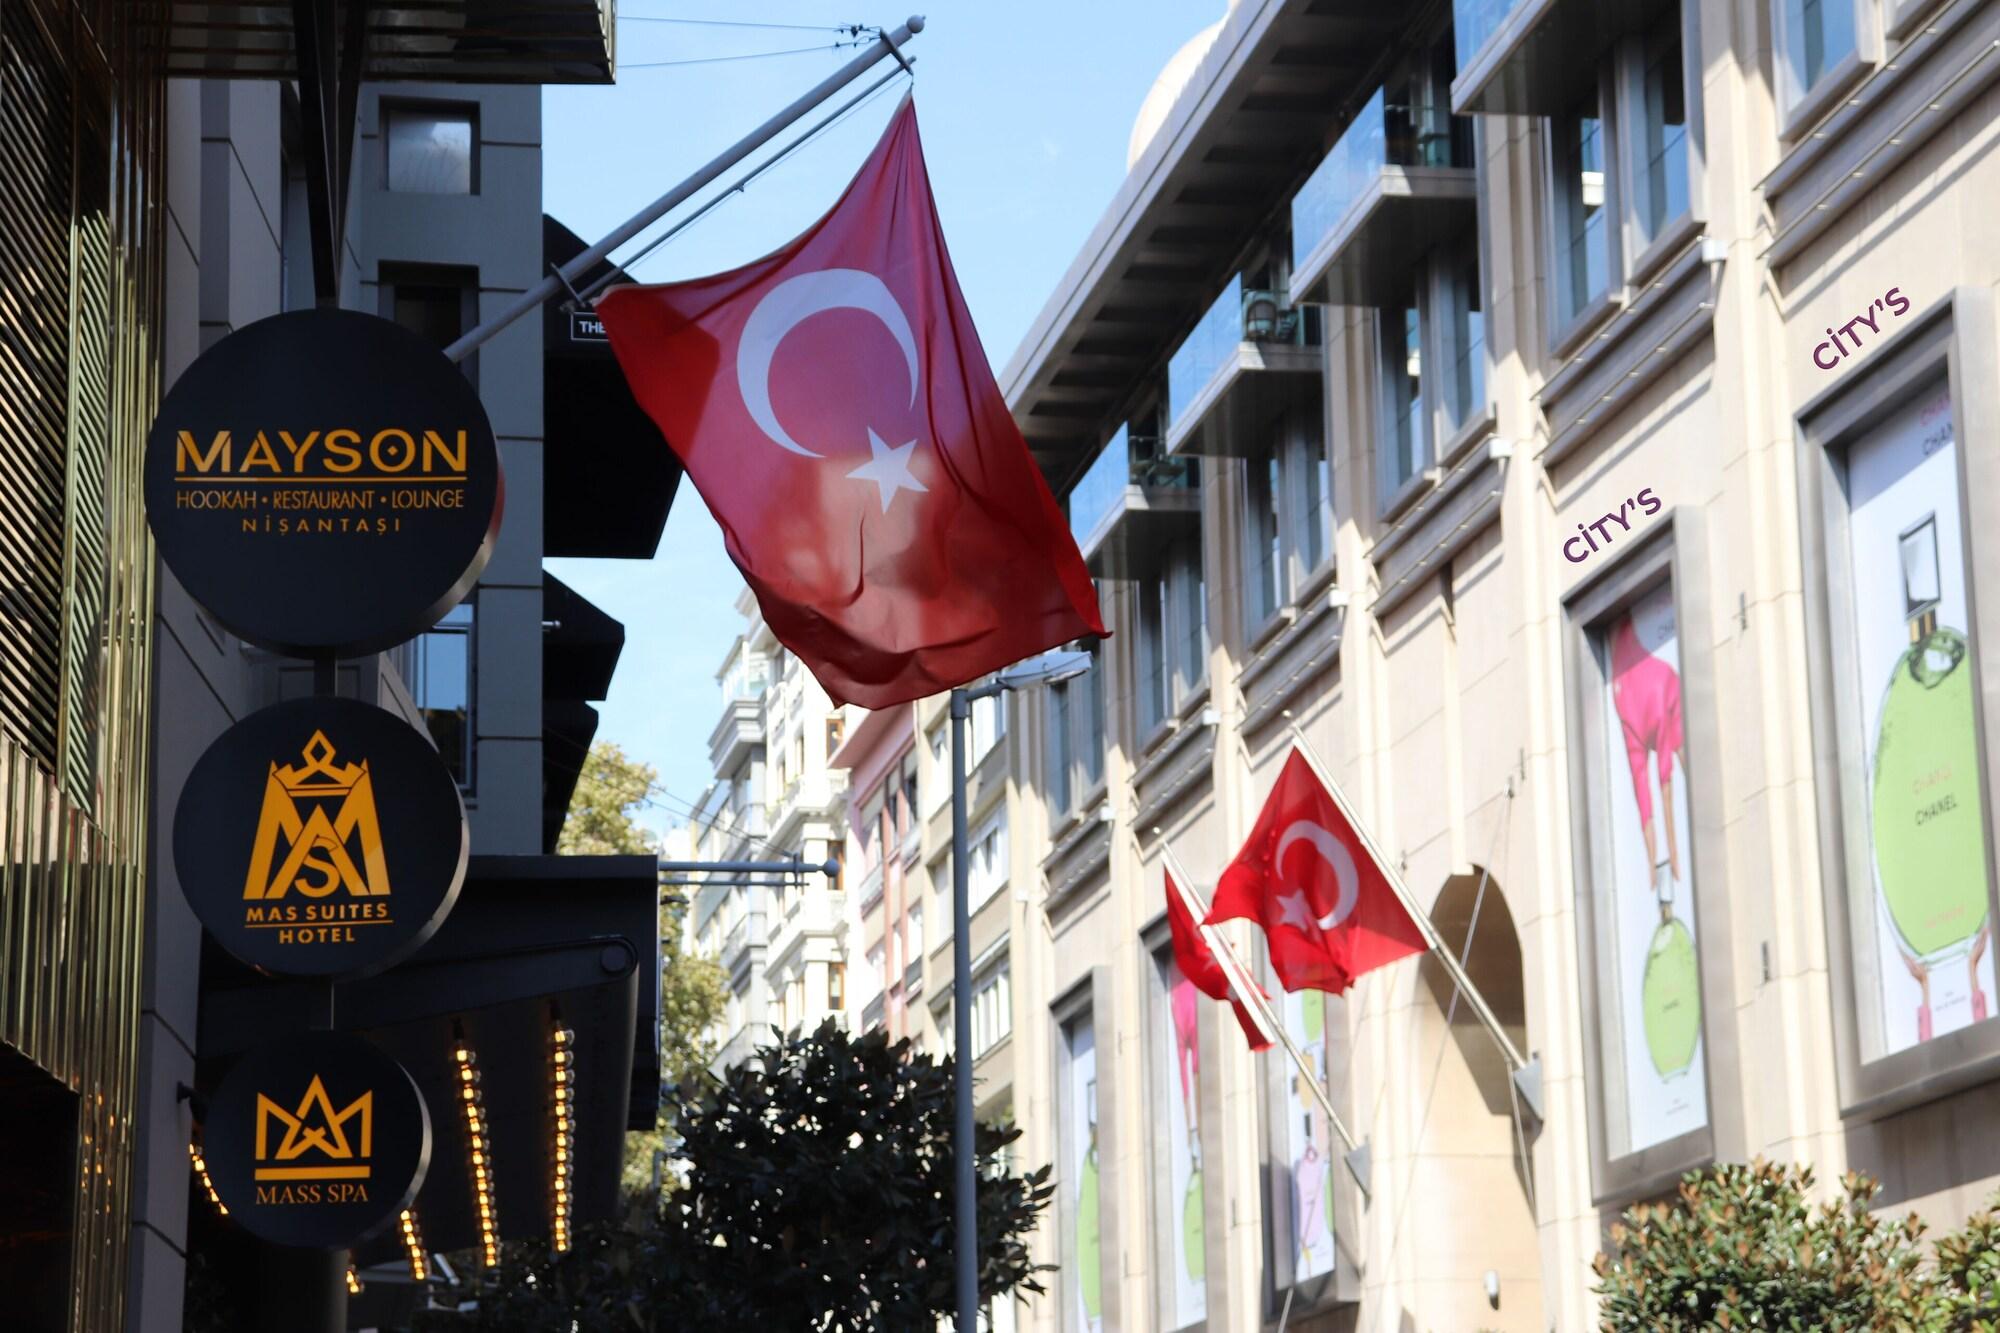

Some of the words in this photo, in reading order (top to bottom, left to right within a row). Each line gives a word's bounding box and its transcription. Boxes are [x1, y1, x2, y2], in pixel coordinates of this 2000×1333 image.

[175, 428, 467, 474] MAYSON
[176, 490, 257, 509] HOOKAH
[272, 490, 375, 509] RESTAURANT
[391, 489, 464, 508] LOUNGE
[242, 515, 400, 535] NİŞANTAŞI
[1914, 792, 1957, 826] CHANEL
[246, 907, 298, 922] MAS
[305, 903, 389, 920] SUITES
[279, 928, 355, 944] HOTEL
[255, 1184, 321, 1205] MASS
[327, 1183, 369, 1204] SPA
